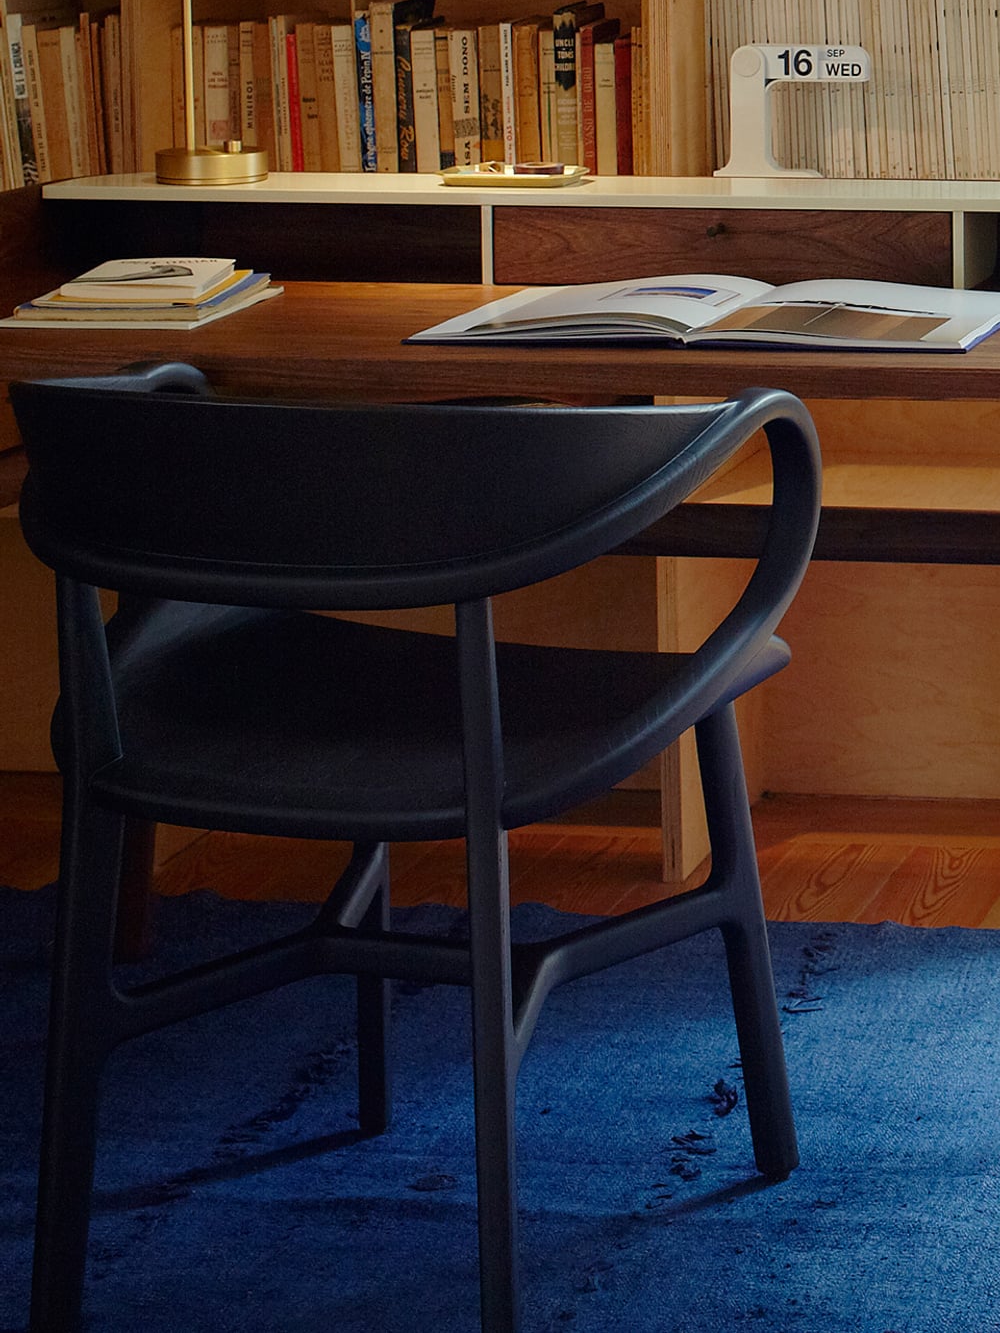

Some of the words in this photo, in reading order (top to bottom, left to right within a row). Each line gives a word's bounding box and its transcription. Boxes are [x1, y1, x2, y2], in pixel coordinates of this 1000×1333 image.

[777, 49, 813, 77] 16
[826, 49, 846, 58] SEP
[826, 63, 862, 77] WED
[362, 84, 372, 94] de
[397, 56, 412, 120] Cannery
[582, 67, 592, 92] OURO
[246, 80, 254, 129] MINEIROS
[584, 98, 592, 112] DE
[400, 125, 415, 160] Row
[585, 118, 593, 146] VASO
[365, 160, 376, 171] Le
